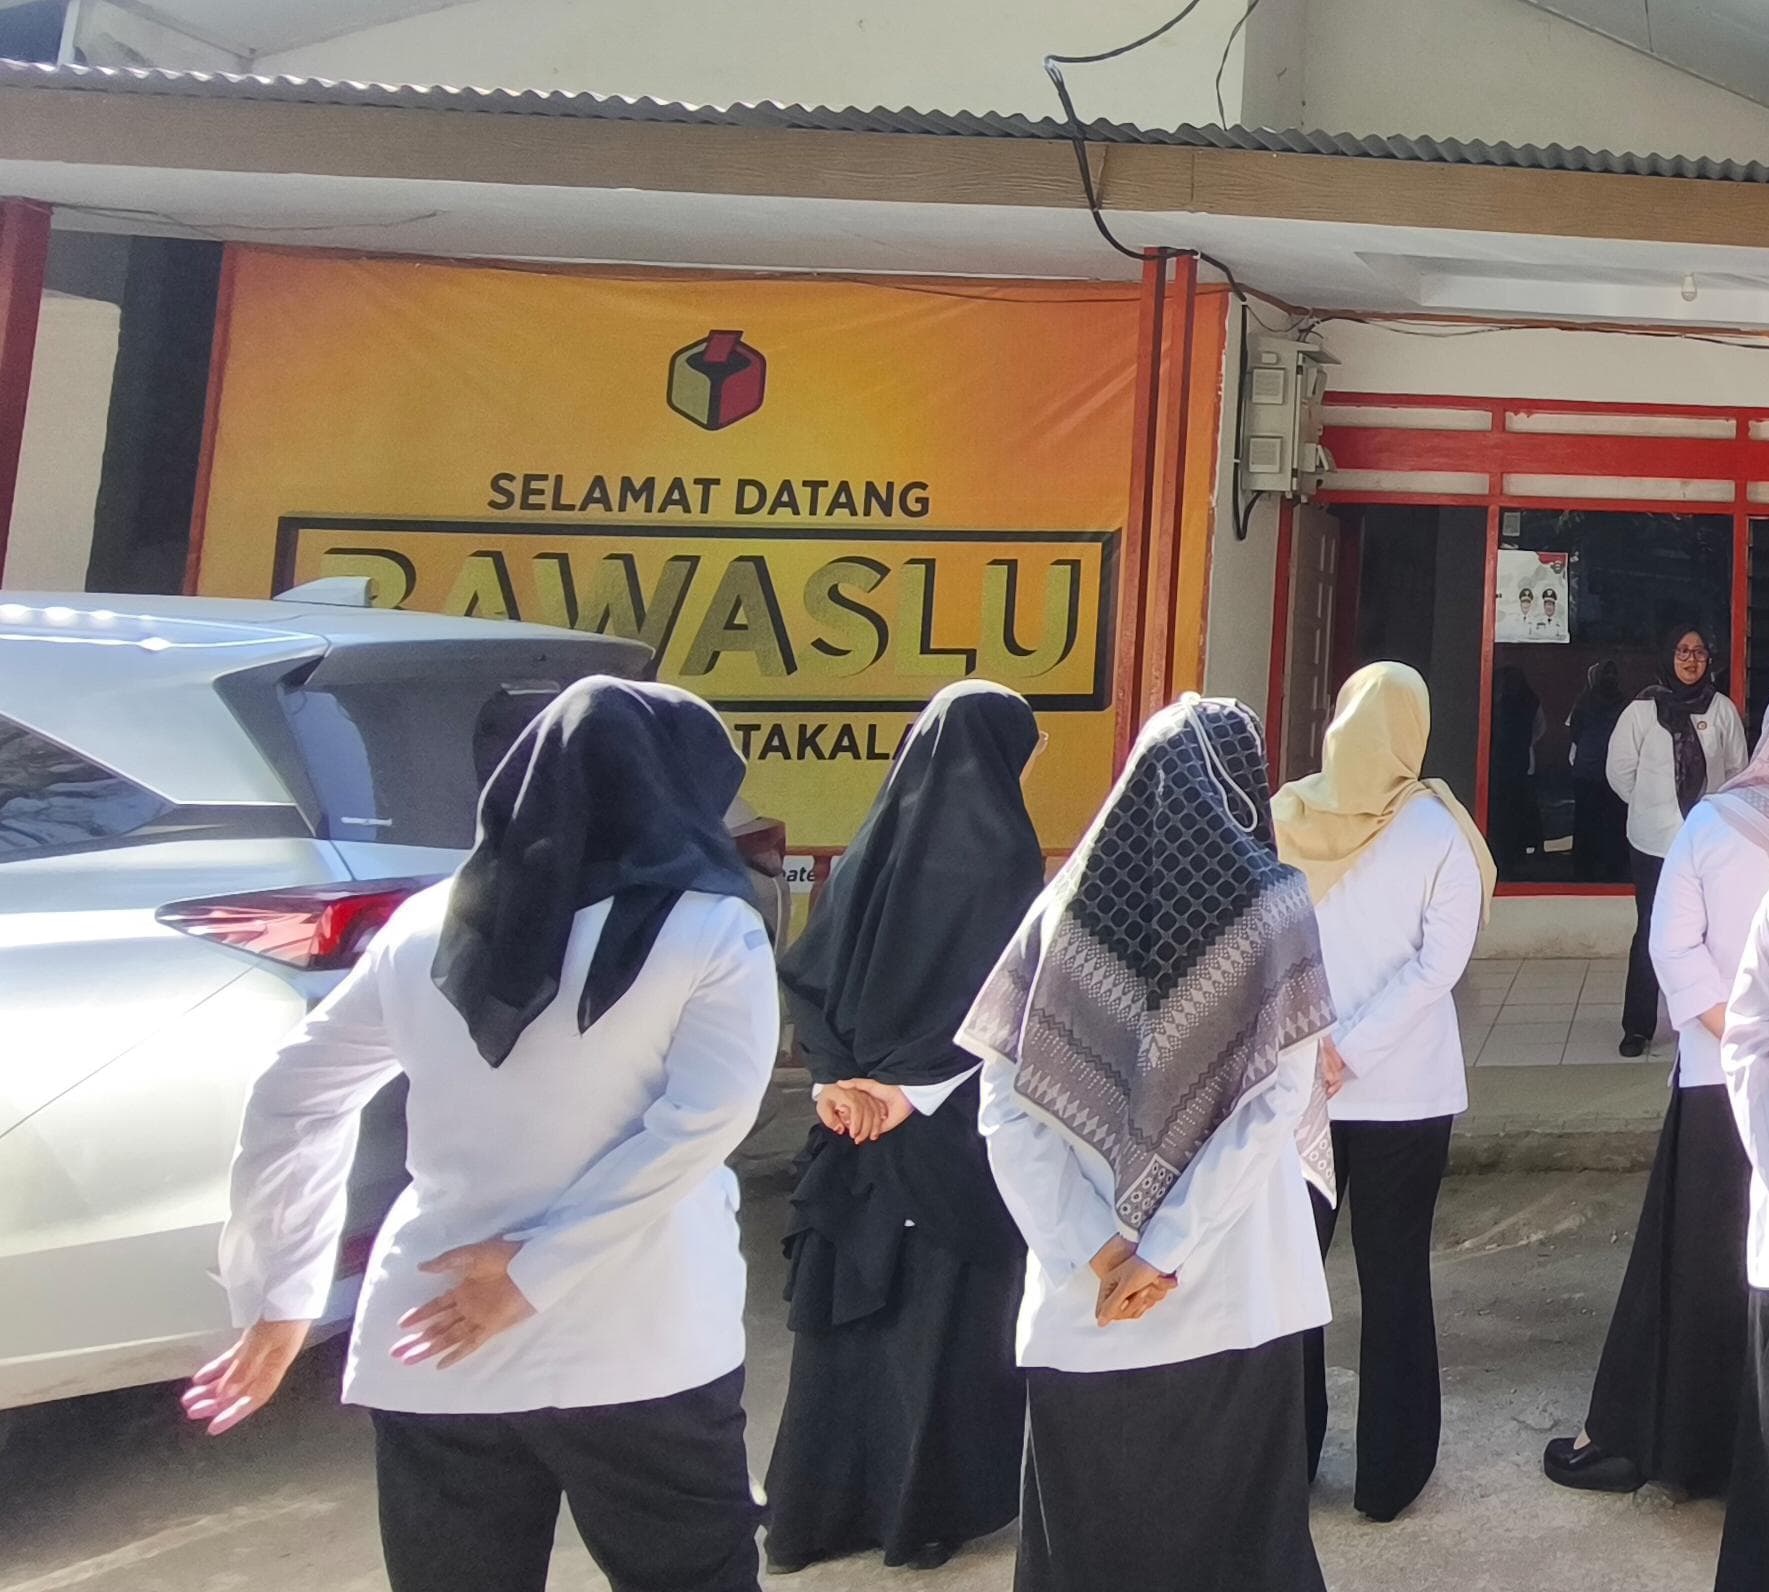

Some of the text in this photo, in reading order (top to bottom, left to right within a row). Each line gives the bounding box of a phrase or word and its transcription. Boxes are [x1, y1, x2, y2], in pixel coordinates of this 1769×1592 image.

[487, 472, 930, 518] SELAMAT DATANG
[733, 723, 916, 761] TAKAL
